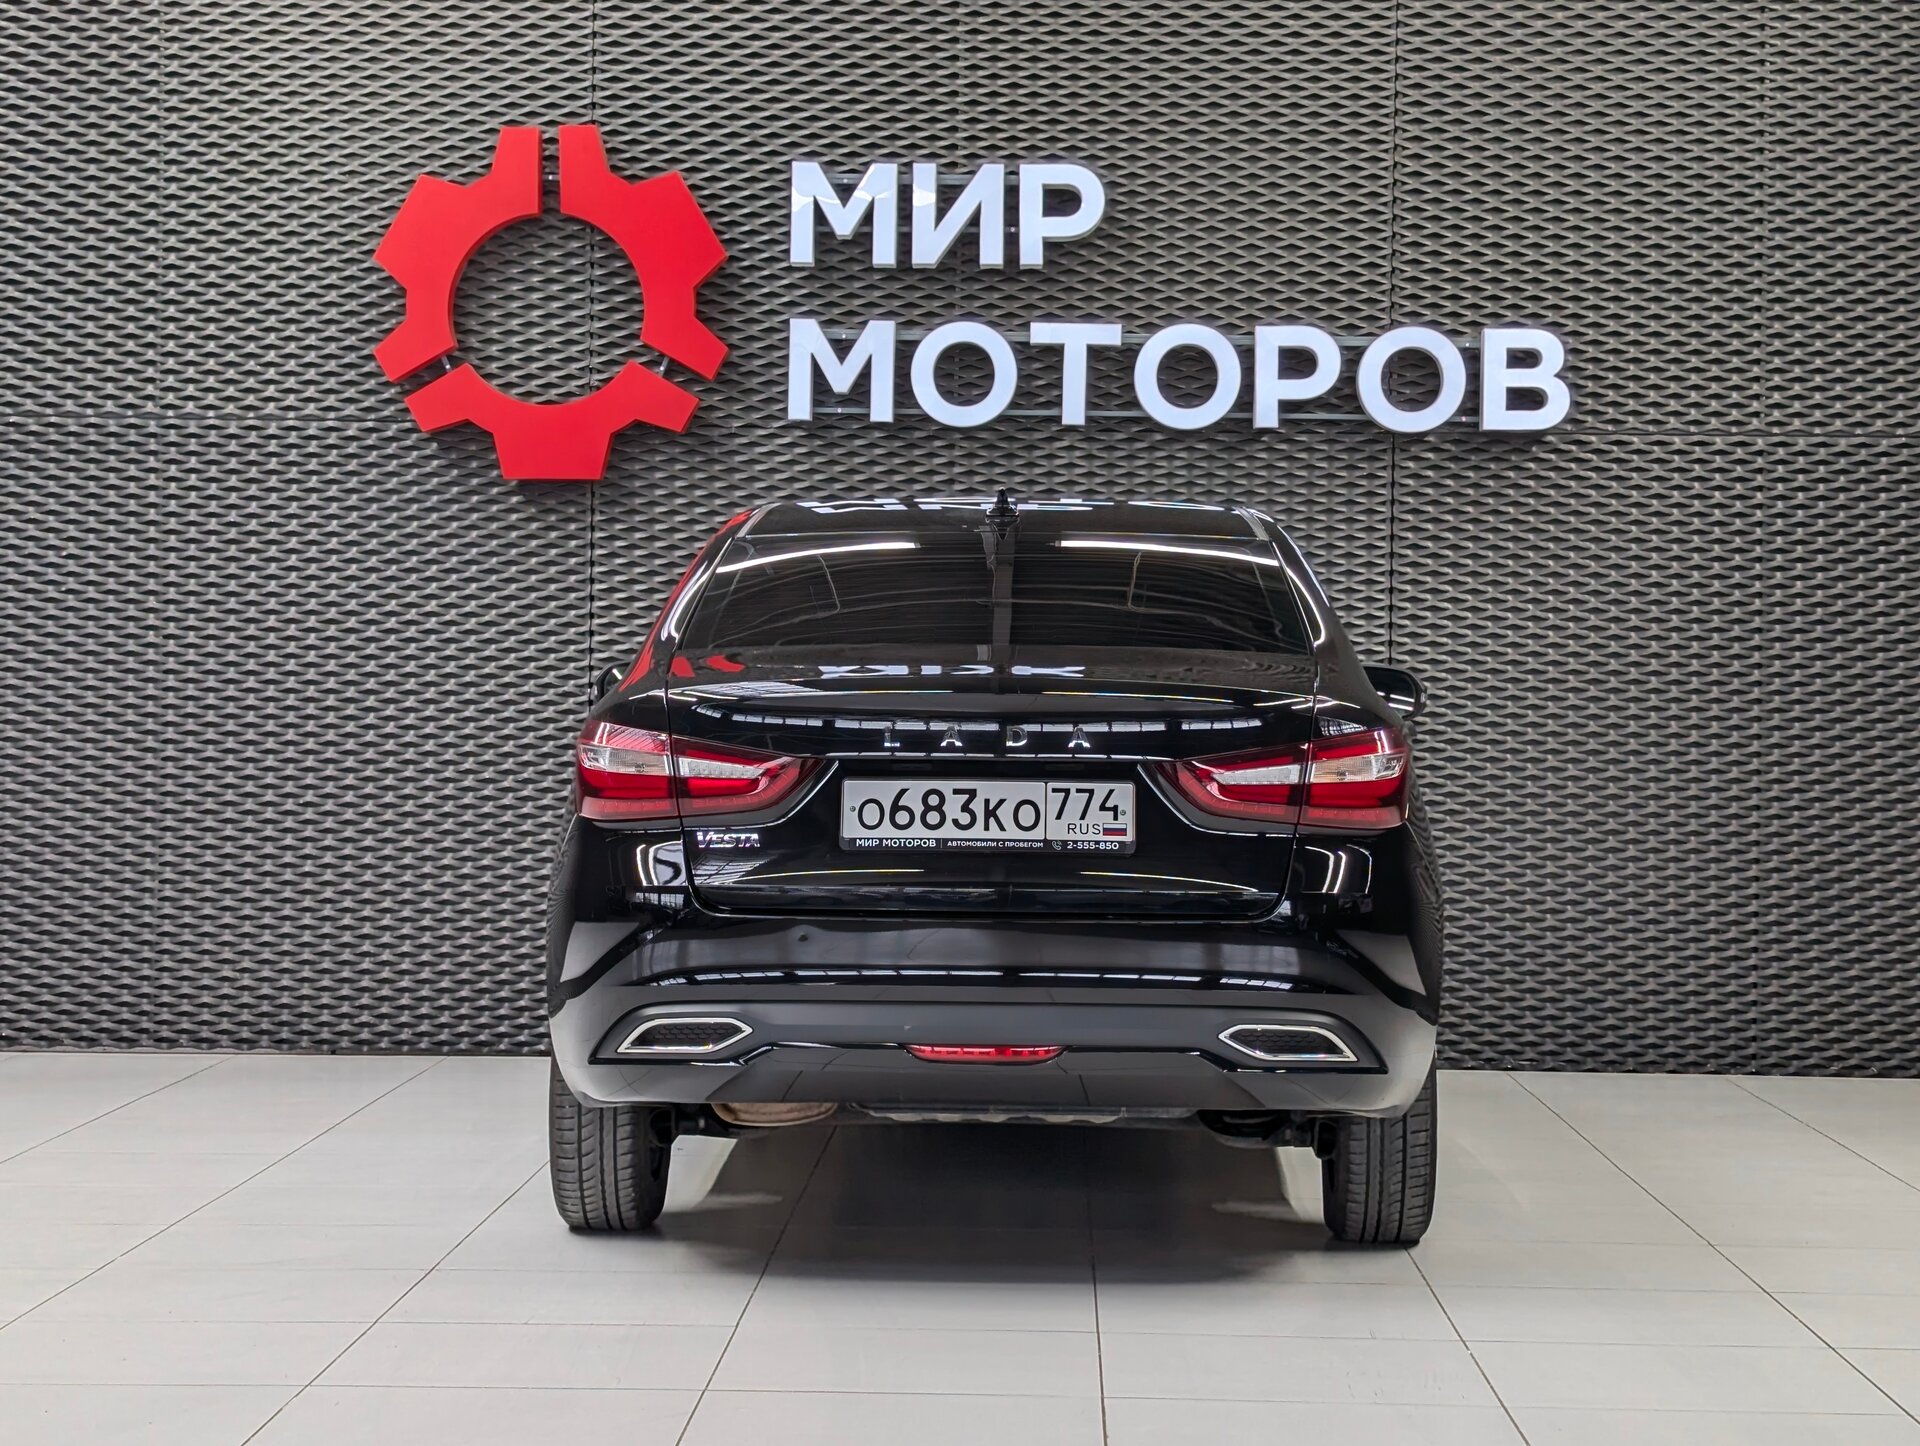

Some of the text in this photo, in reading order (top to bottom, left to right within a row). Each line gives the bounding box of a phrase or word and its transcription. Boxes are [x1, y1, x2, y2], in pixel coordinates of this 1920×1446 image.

[790, 160, 1106, 269] МИР
[787, 317, 1571, 433] МОТОРОВ
[884, 725, 1091, 748] LADA
[1051, 788, 1119, 821] 774
[1067, 823, 1101, 835] RUS
[856, 839, 936, 847] МИР МОТОРОВ
[1067, 841, 1119, 850] 2-555-850
